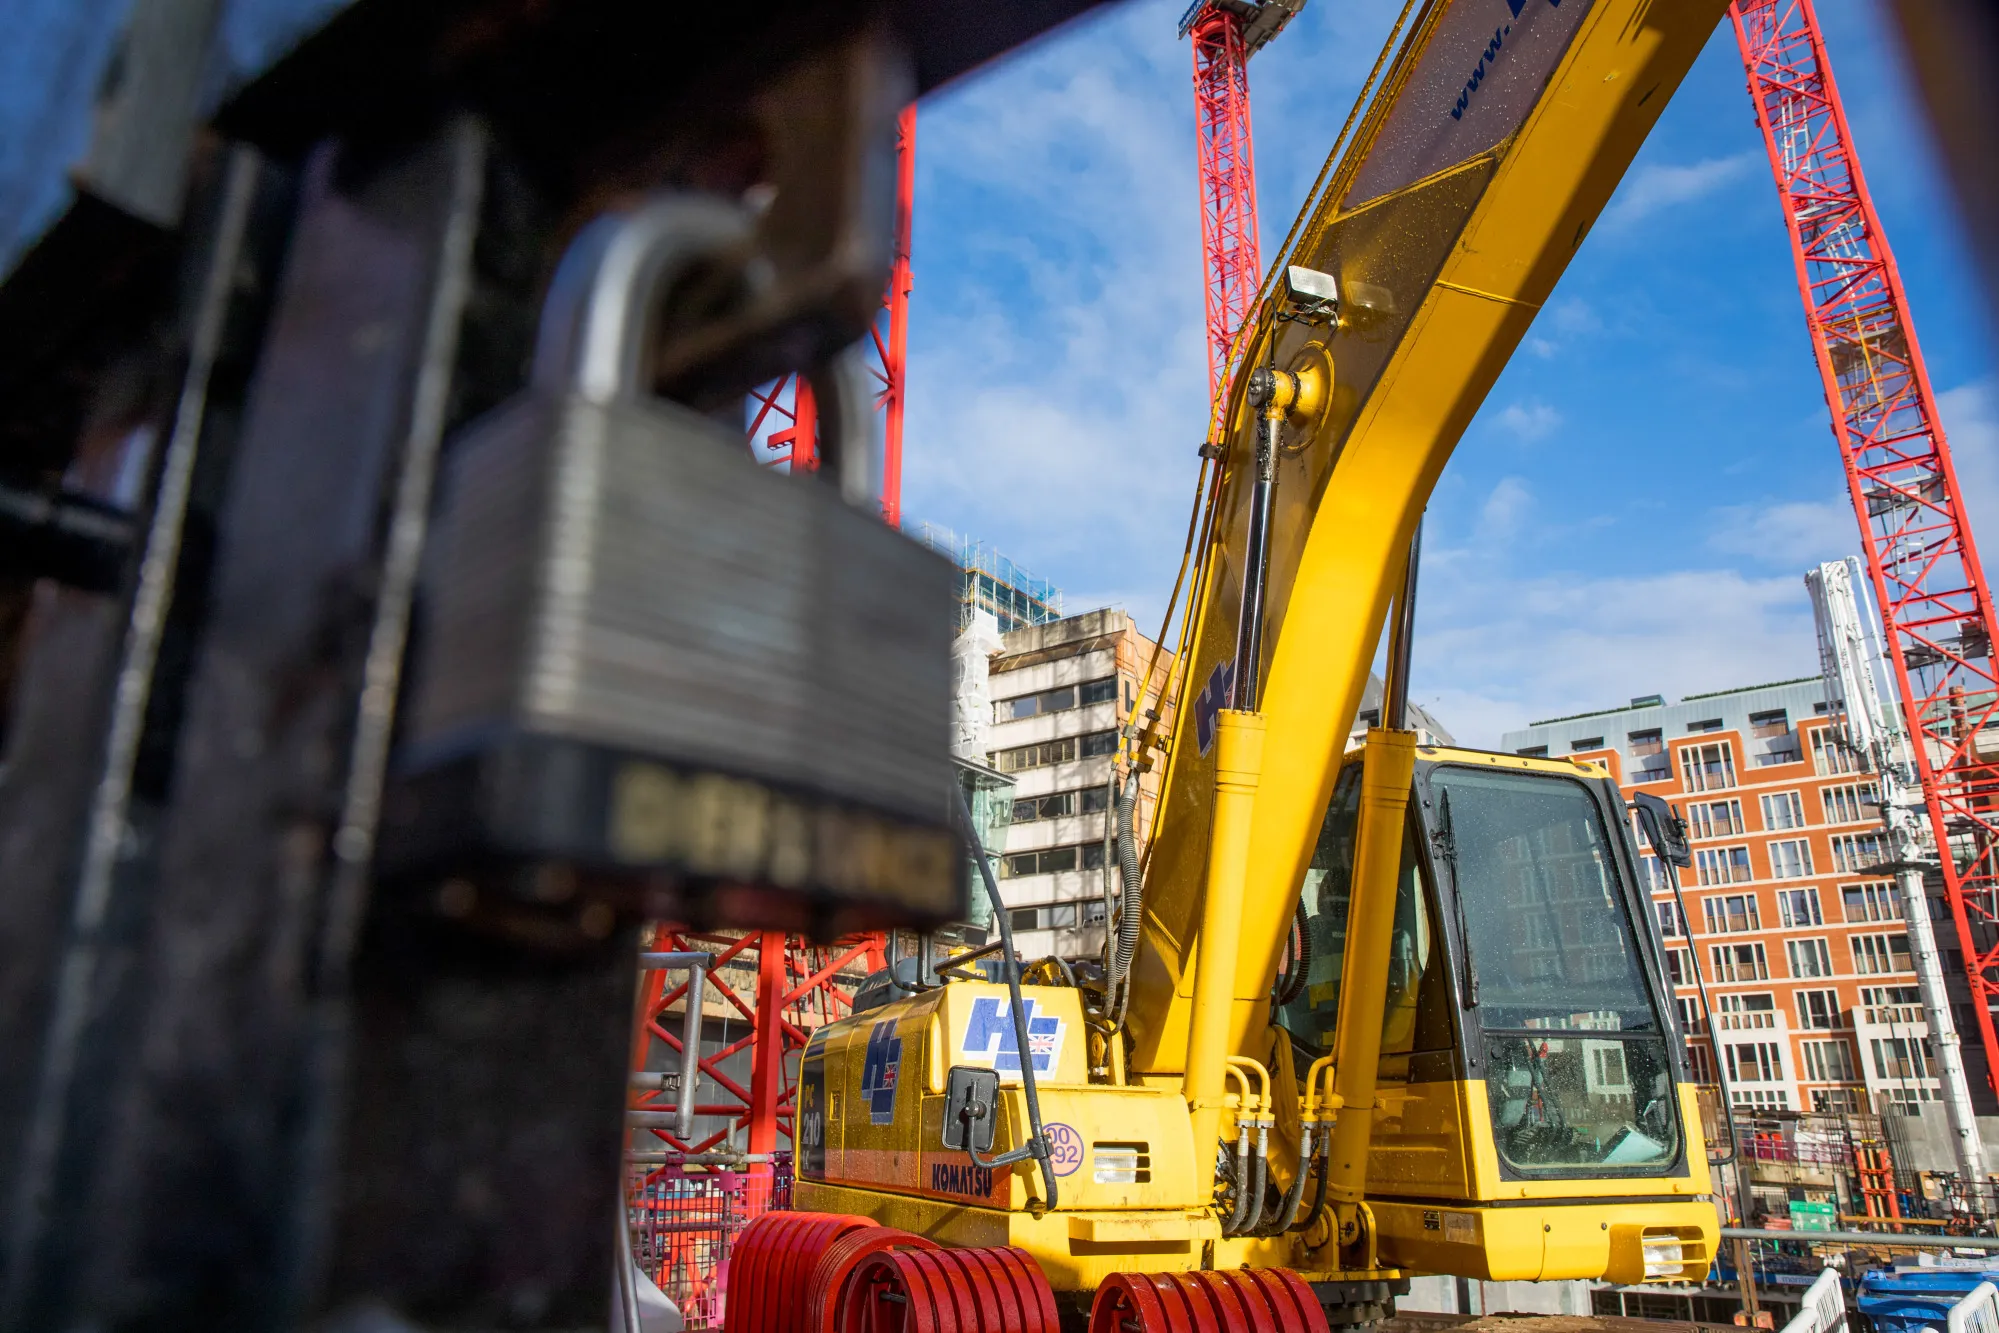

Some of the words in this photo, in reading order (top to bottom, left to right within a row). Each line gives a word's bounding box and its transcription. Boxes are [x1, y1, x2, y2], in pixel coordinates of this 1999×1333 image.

[802, 1111, 821, 1146] 210
[1051, 1145, 1078, 1164] 92
[932, 1163, 993, 1198] KOMATSU
